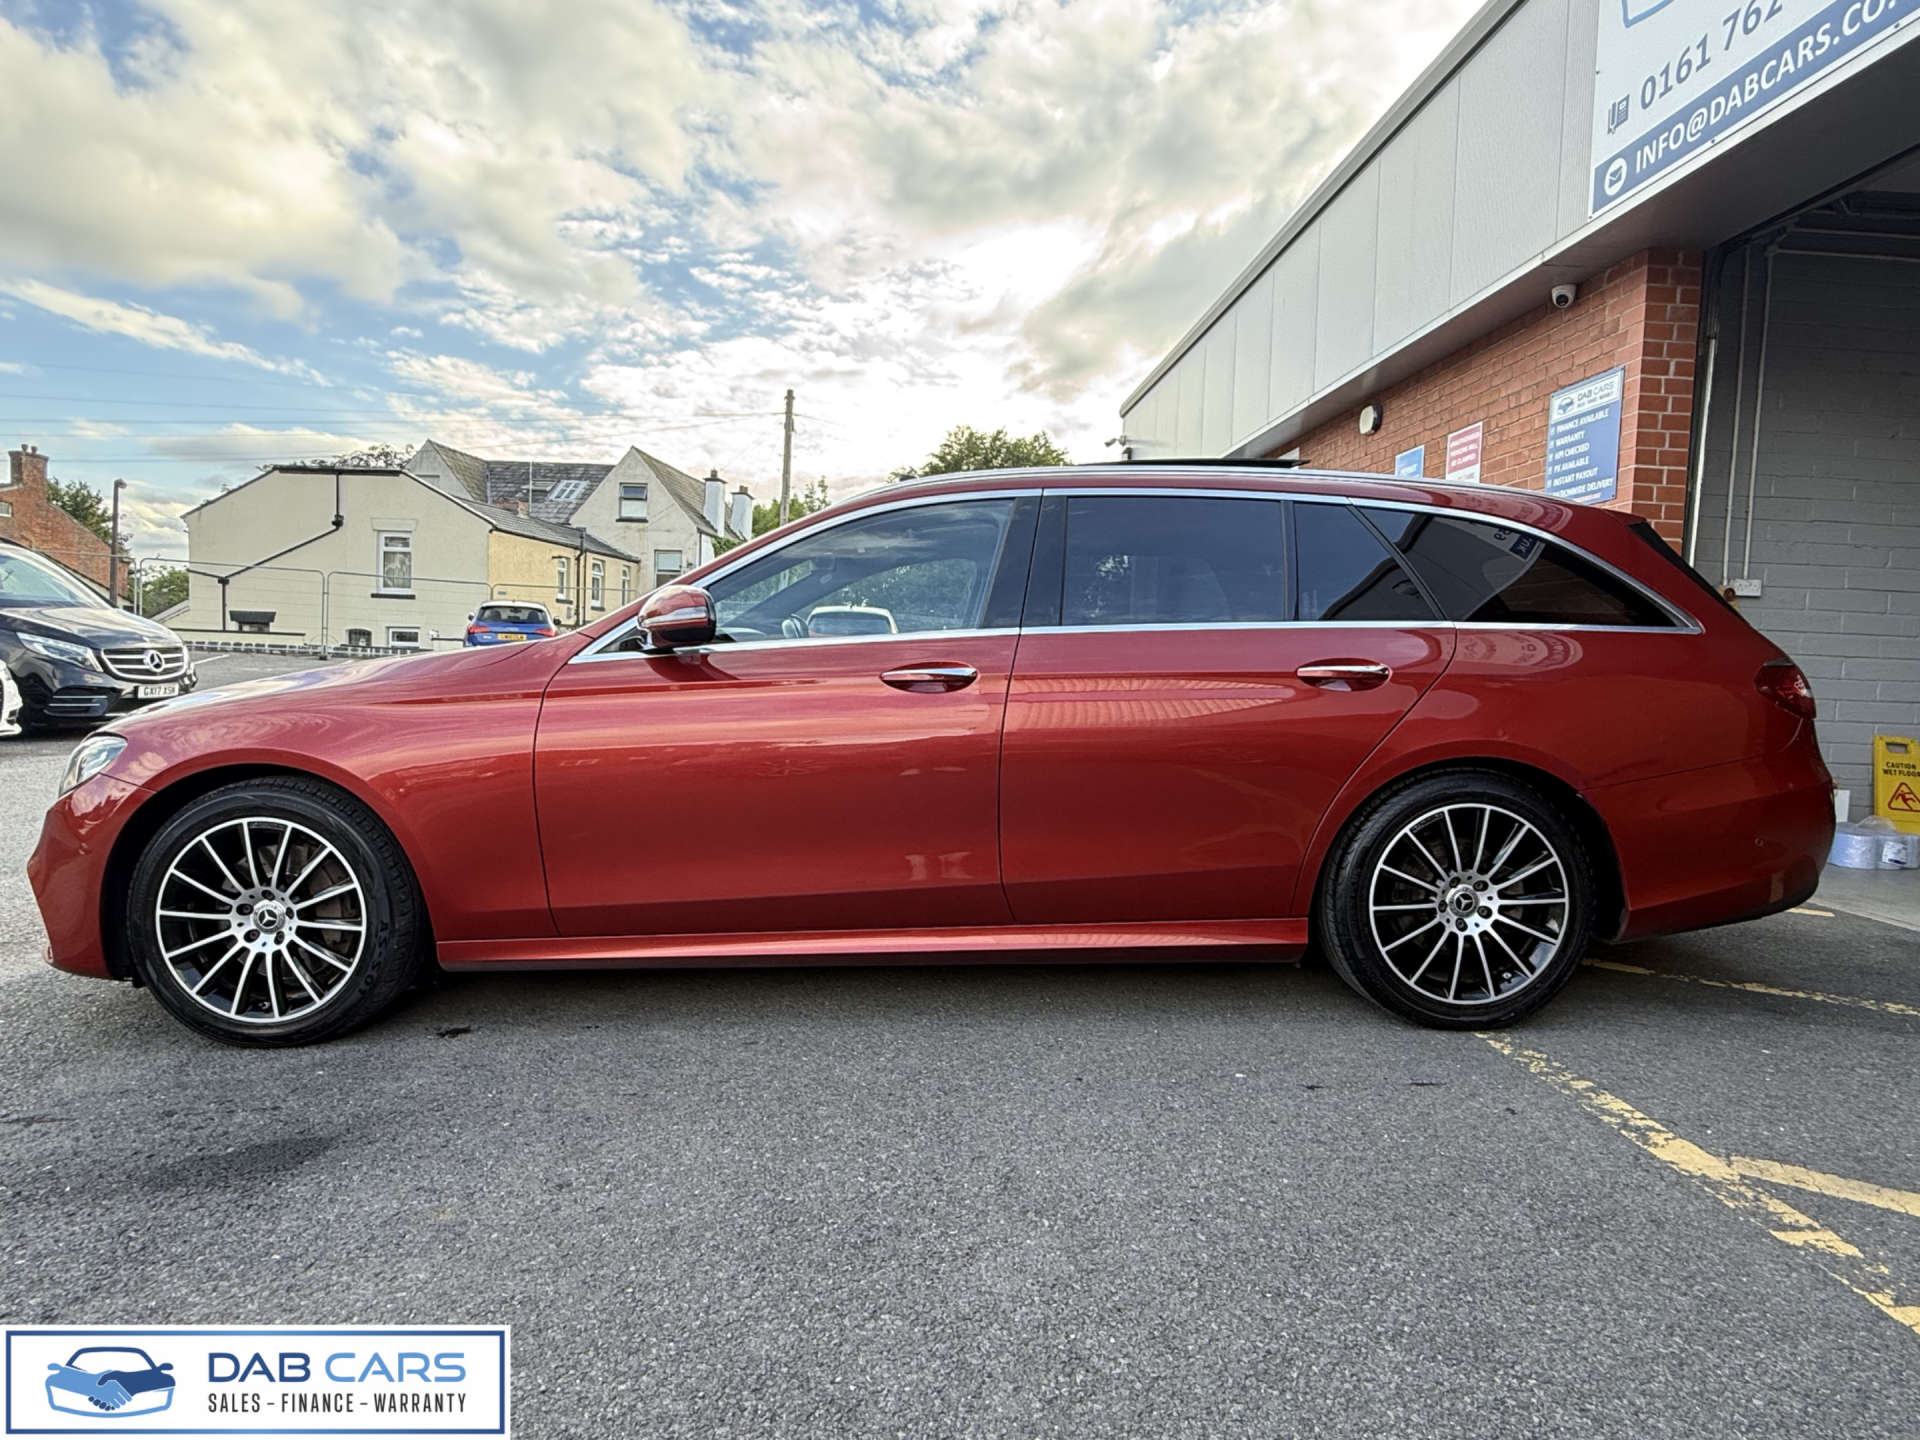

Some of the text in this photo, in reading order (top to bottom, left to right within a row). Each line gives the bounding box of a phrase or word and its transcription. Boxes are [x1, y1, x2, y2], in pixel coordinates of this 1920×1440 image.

[1641, 34, 1711, 110] 0161
[1577, 389, 1592, 401] DAB
[1593, 382, 1614, 396] CARS
[1556, 432, 1585, 446] WARRANTY
[1886, 761, 1917, 770] CAUTION
